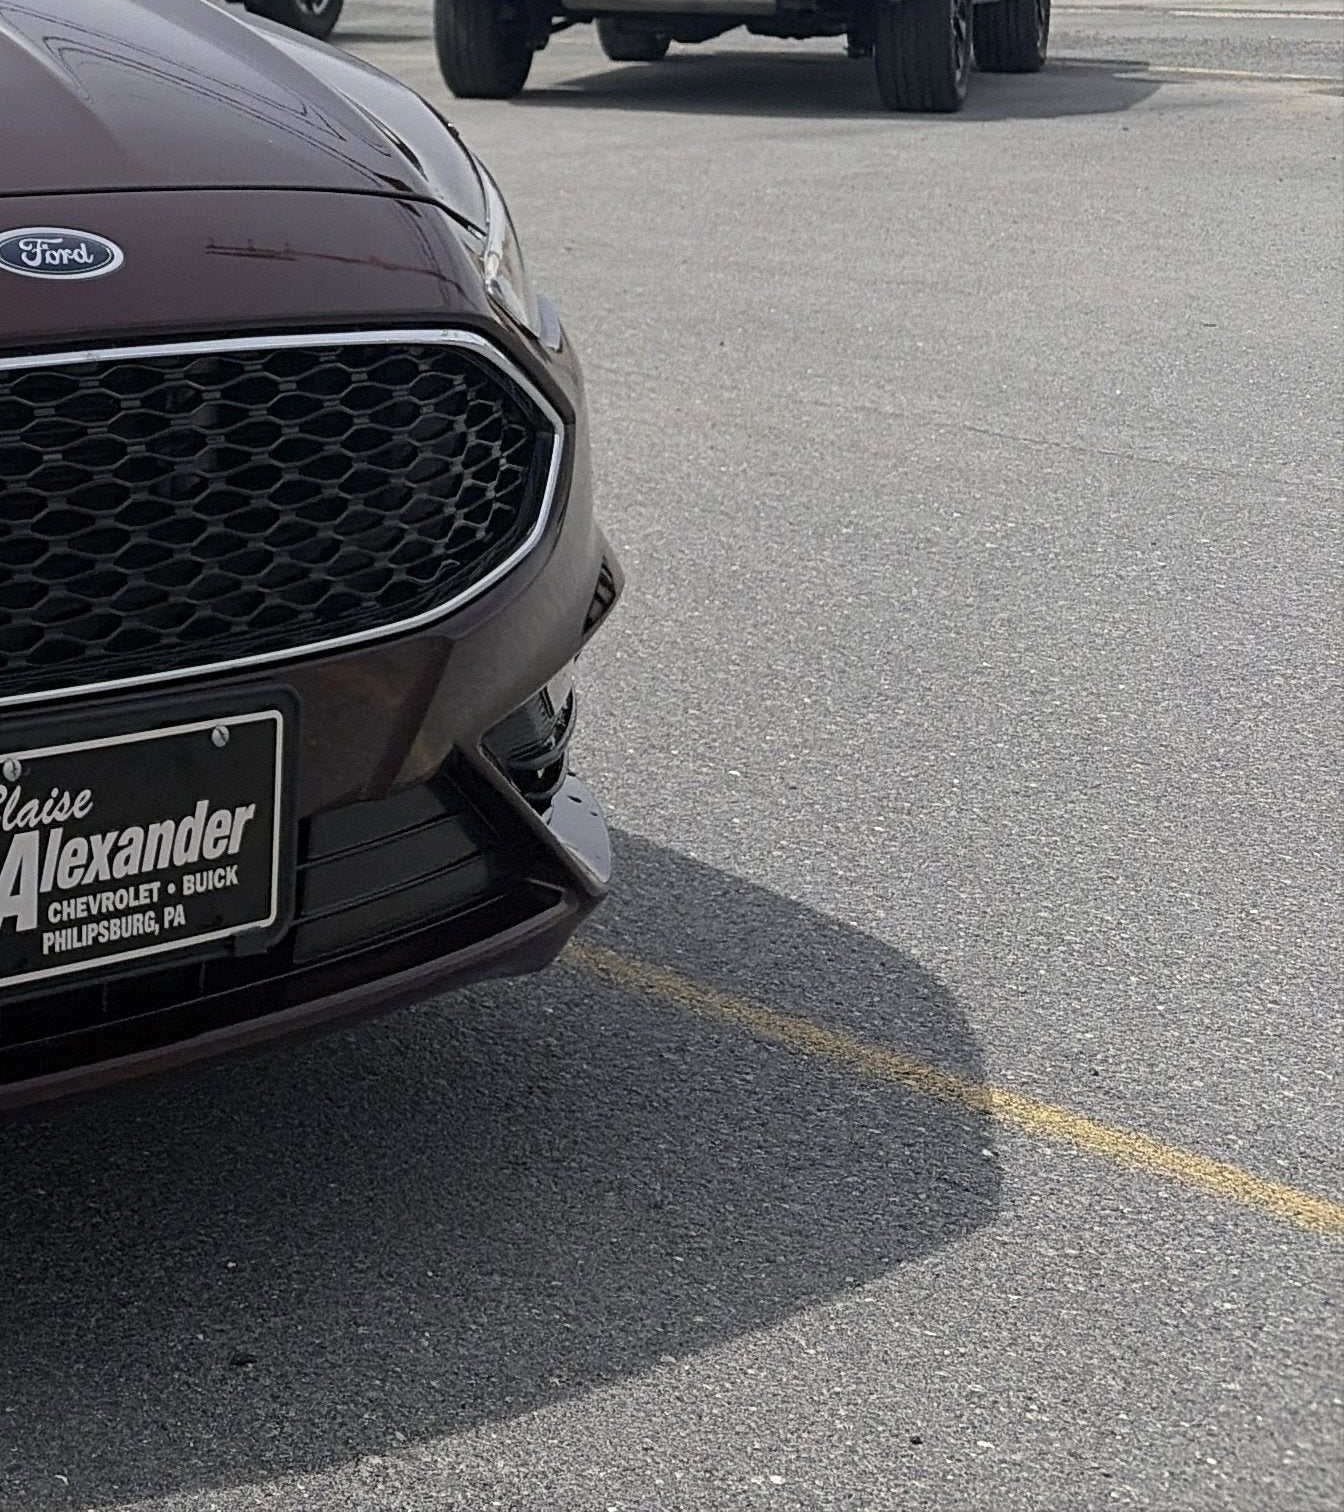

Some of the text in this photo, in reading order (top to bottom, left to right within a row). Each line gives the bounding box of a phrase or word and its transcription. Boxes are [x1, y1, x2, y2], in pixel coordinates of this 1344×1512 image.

[19, 238, 94, 267] Ford
[47, 865, 239, 924] CHEVROLET BUICK
[42, 904, 186, 955] PHILIPSBURG, PA
